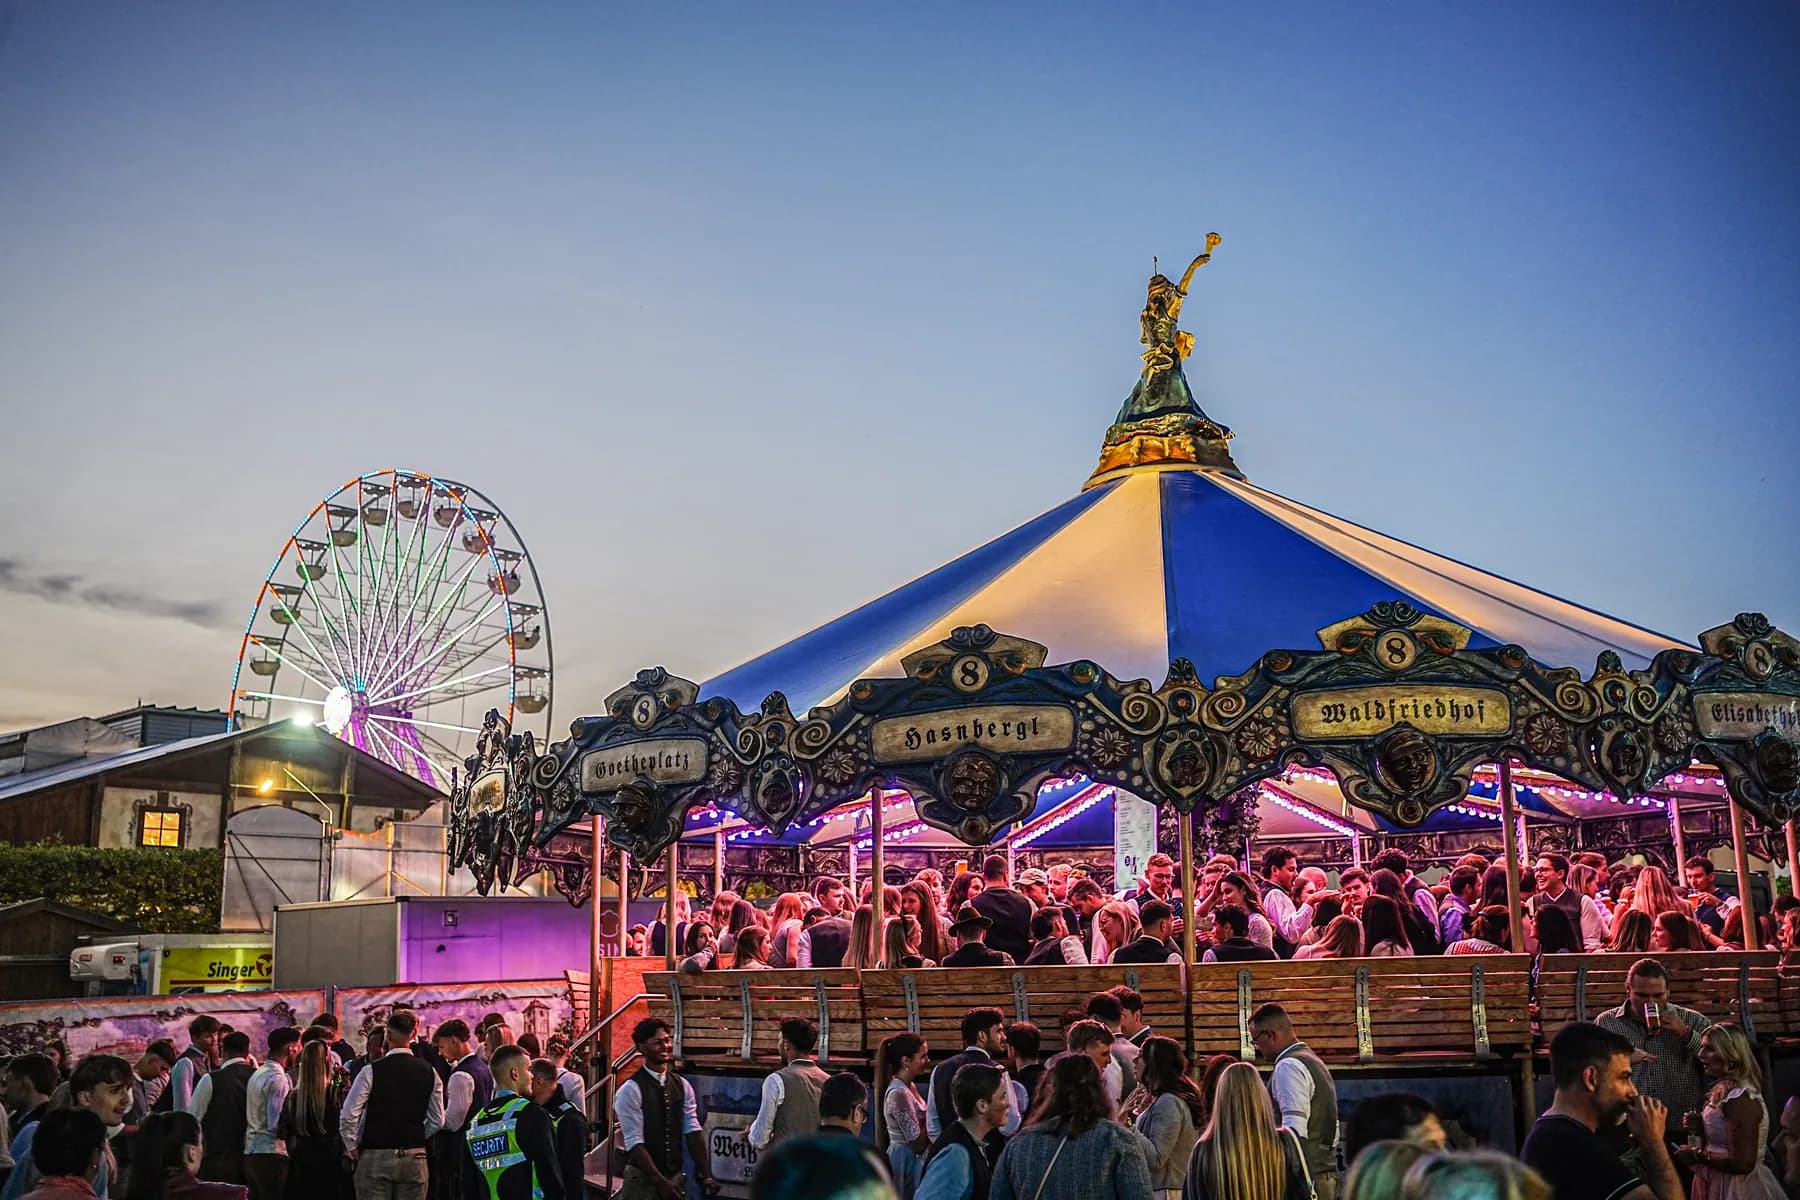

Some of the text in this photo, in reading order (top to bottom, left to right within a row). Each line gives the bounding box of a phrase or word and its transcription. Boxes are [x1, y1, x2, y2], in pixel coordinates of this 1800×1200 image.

[1385, 637, 1406, 664] 8
[1753, 647, 1770, 673] 8
[960, 660, 980, 686] 8
[638, 700, 650, 723] 8
[1321, 699, 1485, 724] Waldfriedhof
[904, 717, 1040, 750] Hasnbergl
[595, 750, 689, 779] Goetheplatz
[207, 961, 255, 981] Singer
[472, 1135, 505, 1157] SECURITY
